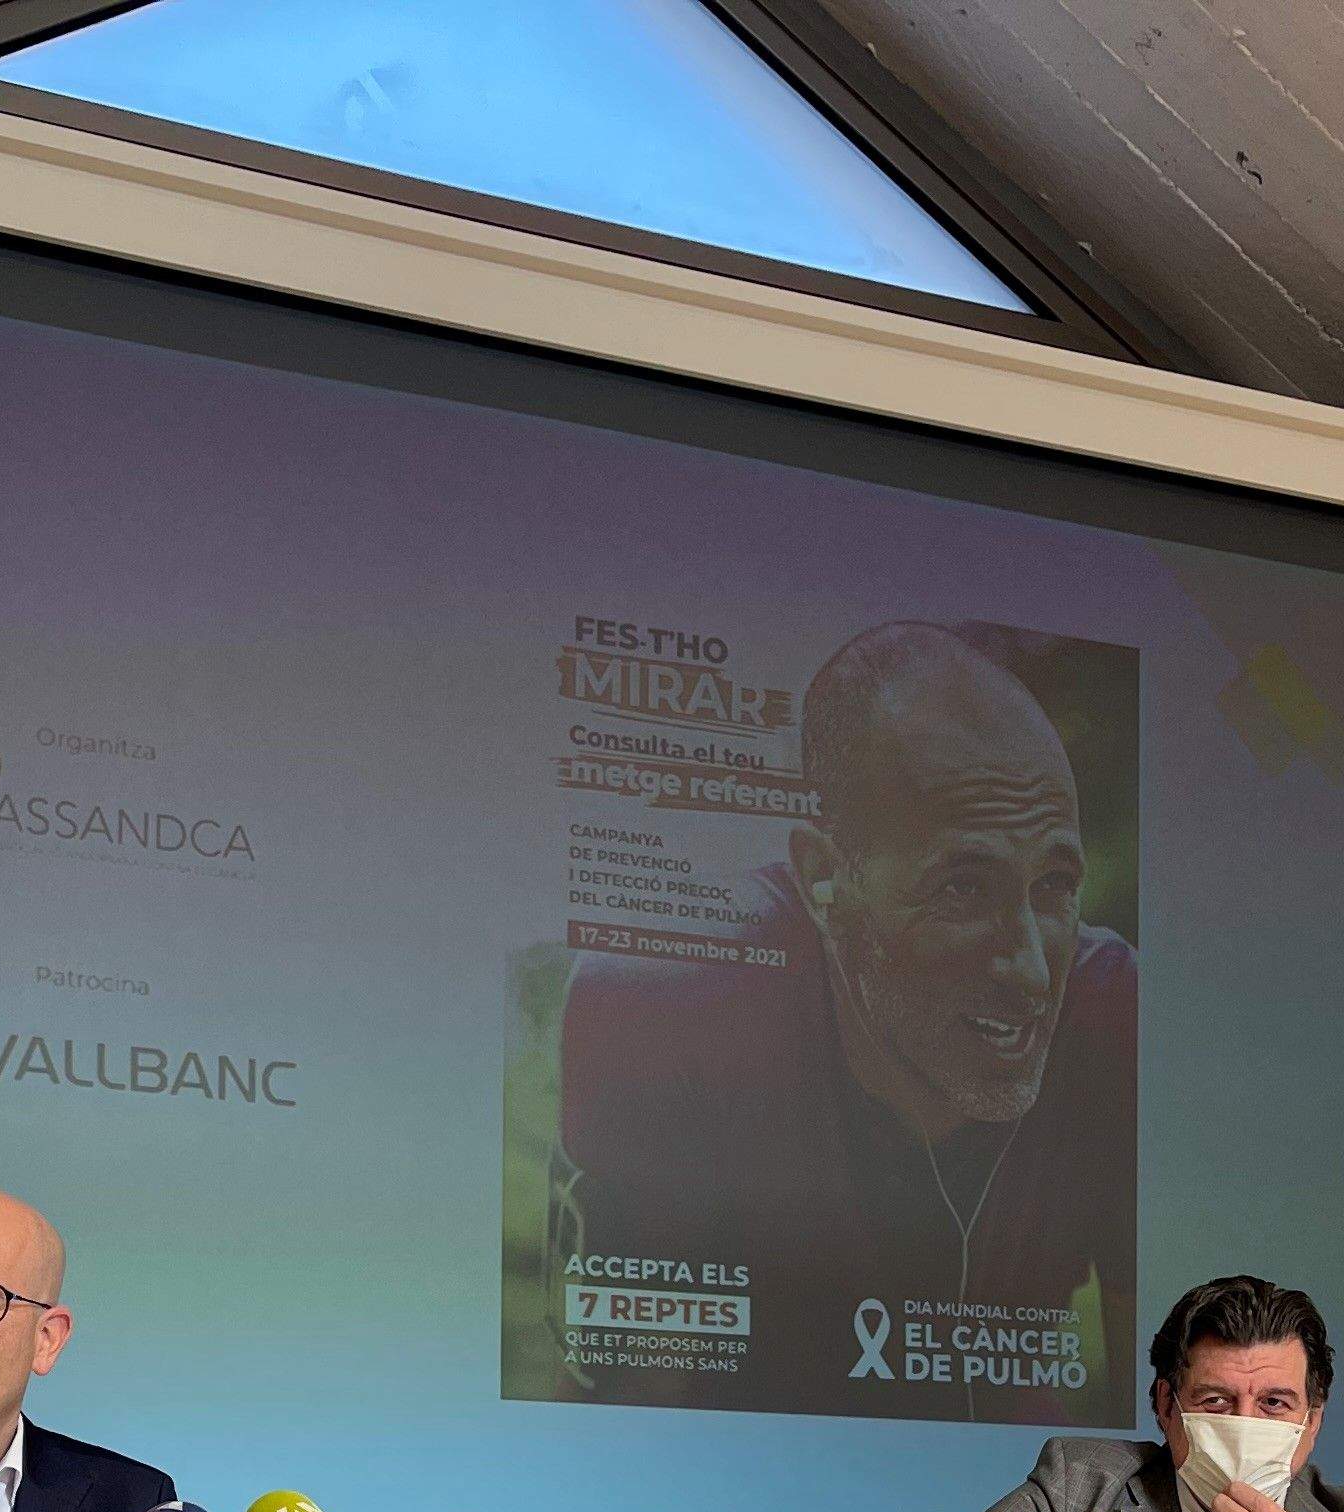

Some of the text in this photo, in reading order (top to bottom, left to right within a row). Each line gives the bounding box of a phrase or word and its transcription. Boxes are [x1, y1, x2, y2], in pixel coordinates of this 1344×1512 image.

[575, 652, 766, 726] MIRAR
[36, 727, 157, 761] Organitza
[569, 725, 765, 770] Consulta el teu
[570, 760, 822, 817] metge referent
[569, 824, 664, 848] CAMPANYA
[569, 846, 692, 874] DE PREVENCIÓ
[569, 890, 601, 907] DEL
[605, 893, 674, 916] CÀNCER
[678, 905, 701, 919] DE
[579, 869, 662, 892] DETECCIÓ
[666, 881, 733, 906] PRECOÇ
[578, 926, 787, 967] 17-23 novembre 2021
[35, 966, 151, 996] Patrocina
[564, 1253, 751, 1288] ACCEPTA ELS
[578, 1292, 740, 1329] 7 REPTES
[904, 1300, 1081, 1324] DIA MUNDIAL CONTRA
[565, 1331, 748, 1355] QUE ET PROPOSEM PER
[905, 1319, 1081, 1356] EL CÀNCER
[564, 1350, 739, 1373] A UNS PULMONS SANS
[905, 1352, 1088, 1390] DE PULMÓ
